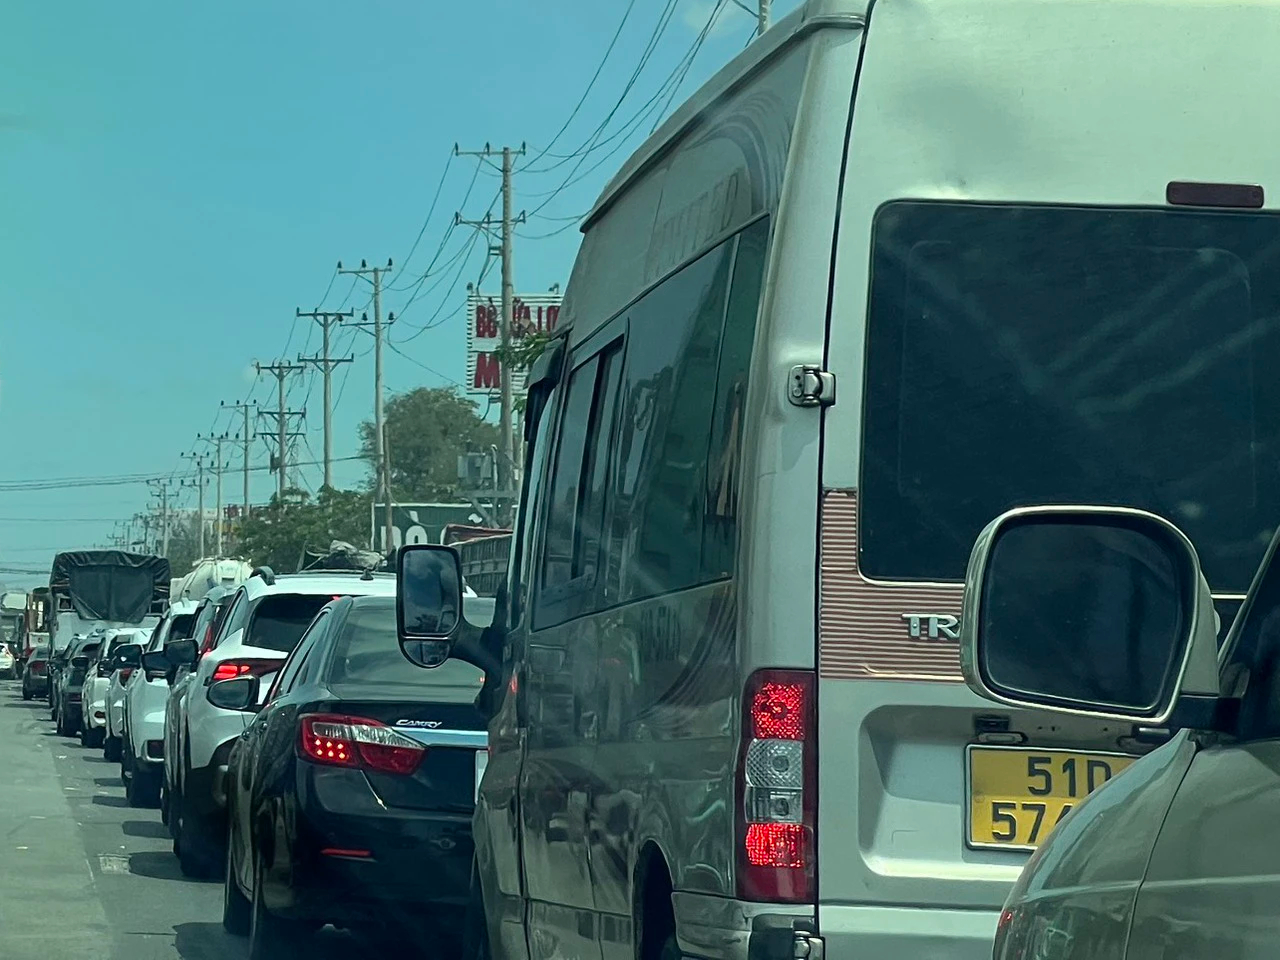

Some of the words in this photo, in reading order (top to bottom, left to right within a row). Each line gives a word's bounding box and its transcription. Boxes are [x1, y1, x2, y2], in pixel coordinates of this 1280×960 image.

[902, 613, 961, 638] TR
[396, 719, 442, 728] CAMRY
[991, 801, 1074, 844] 57
